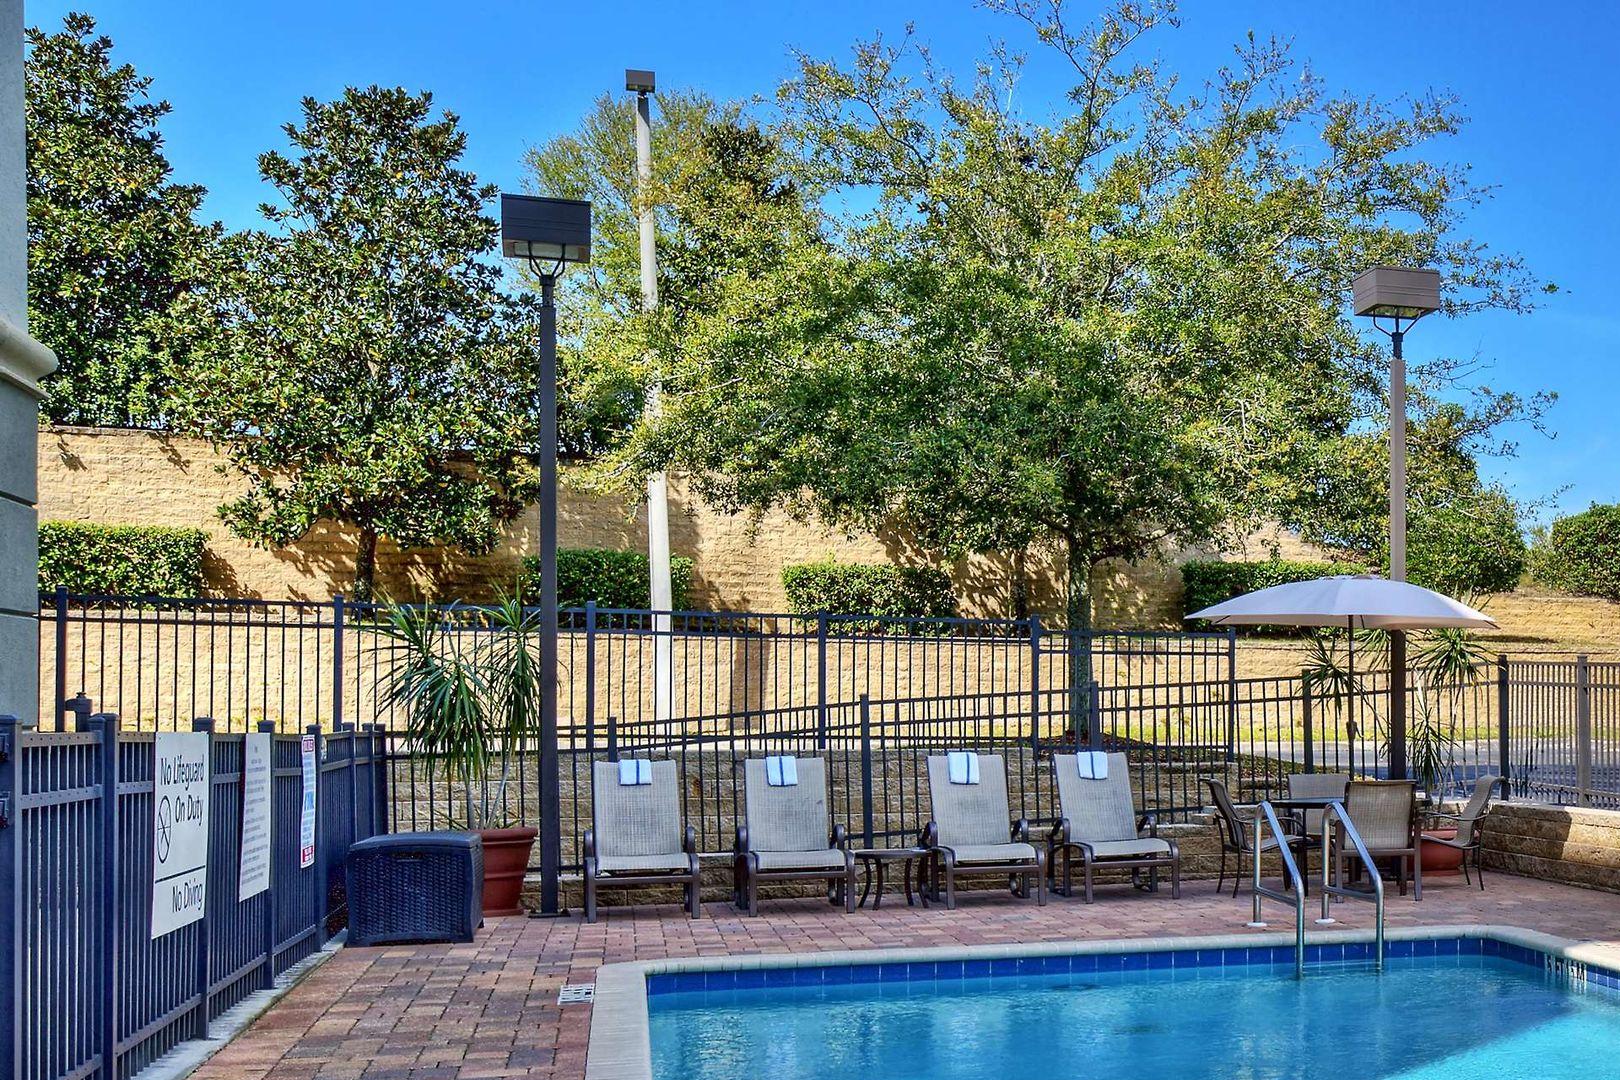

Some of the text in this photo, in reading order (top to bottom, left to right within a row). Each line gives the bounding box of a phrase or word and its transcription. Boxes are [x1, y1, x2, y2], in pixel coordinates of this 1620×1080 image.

[161, 754, 204, 791] No Lifeguard
[175, 794, 204, 826] On Duty
[172, 878, 203, 913] No Diving
